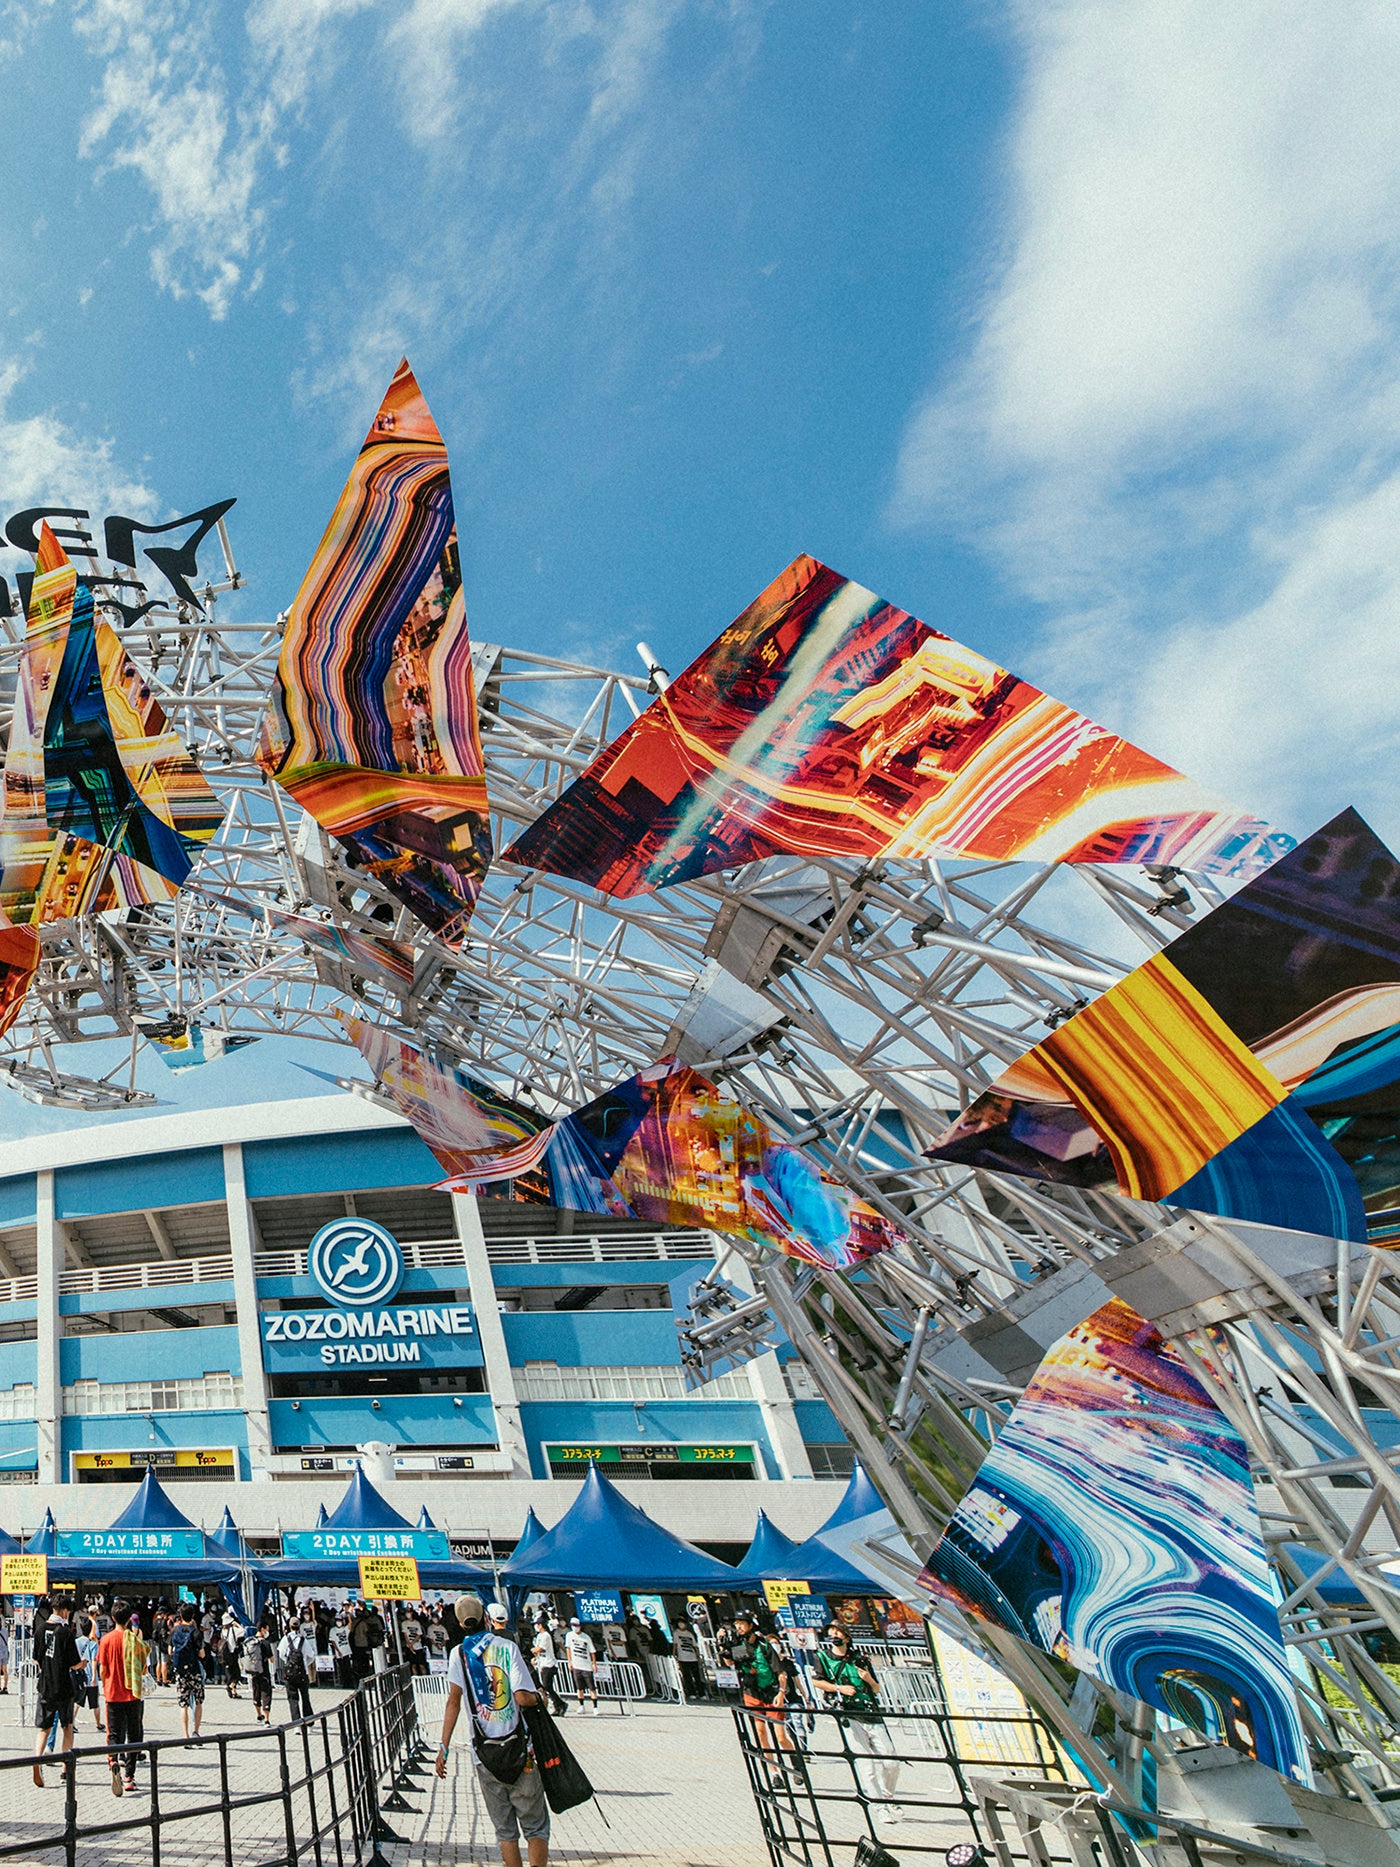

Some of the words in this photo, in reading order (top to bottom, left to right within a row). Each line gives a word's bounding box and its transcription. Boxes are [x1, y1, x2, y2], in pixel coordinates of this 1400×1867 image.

[265, 1307, 473, 1341] ZOZOMARINE
[320, 1342, 420, 1365] STADIUM
[694, 1448, 736, 1459] コアラのマーチ
[83, 1534, 126, 1547] 2DAY
[132, 1534, 172, 1548] 引換所
[313, 1534, 362, 1548] 2DAY
[369, 1534, 414, 1549] 引換所
[450, 1545, 491, 1556] TADIUM
[581, 1605, 619, 1613] リストバンド
[794, 1603, 824, 1611] PLATINUM
